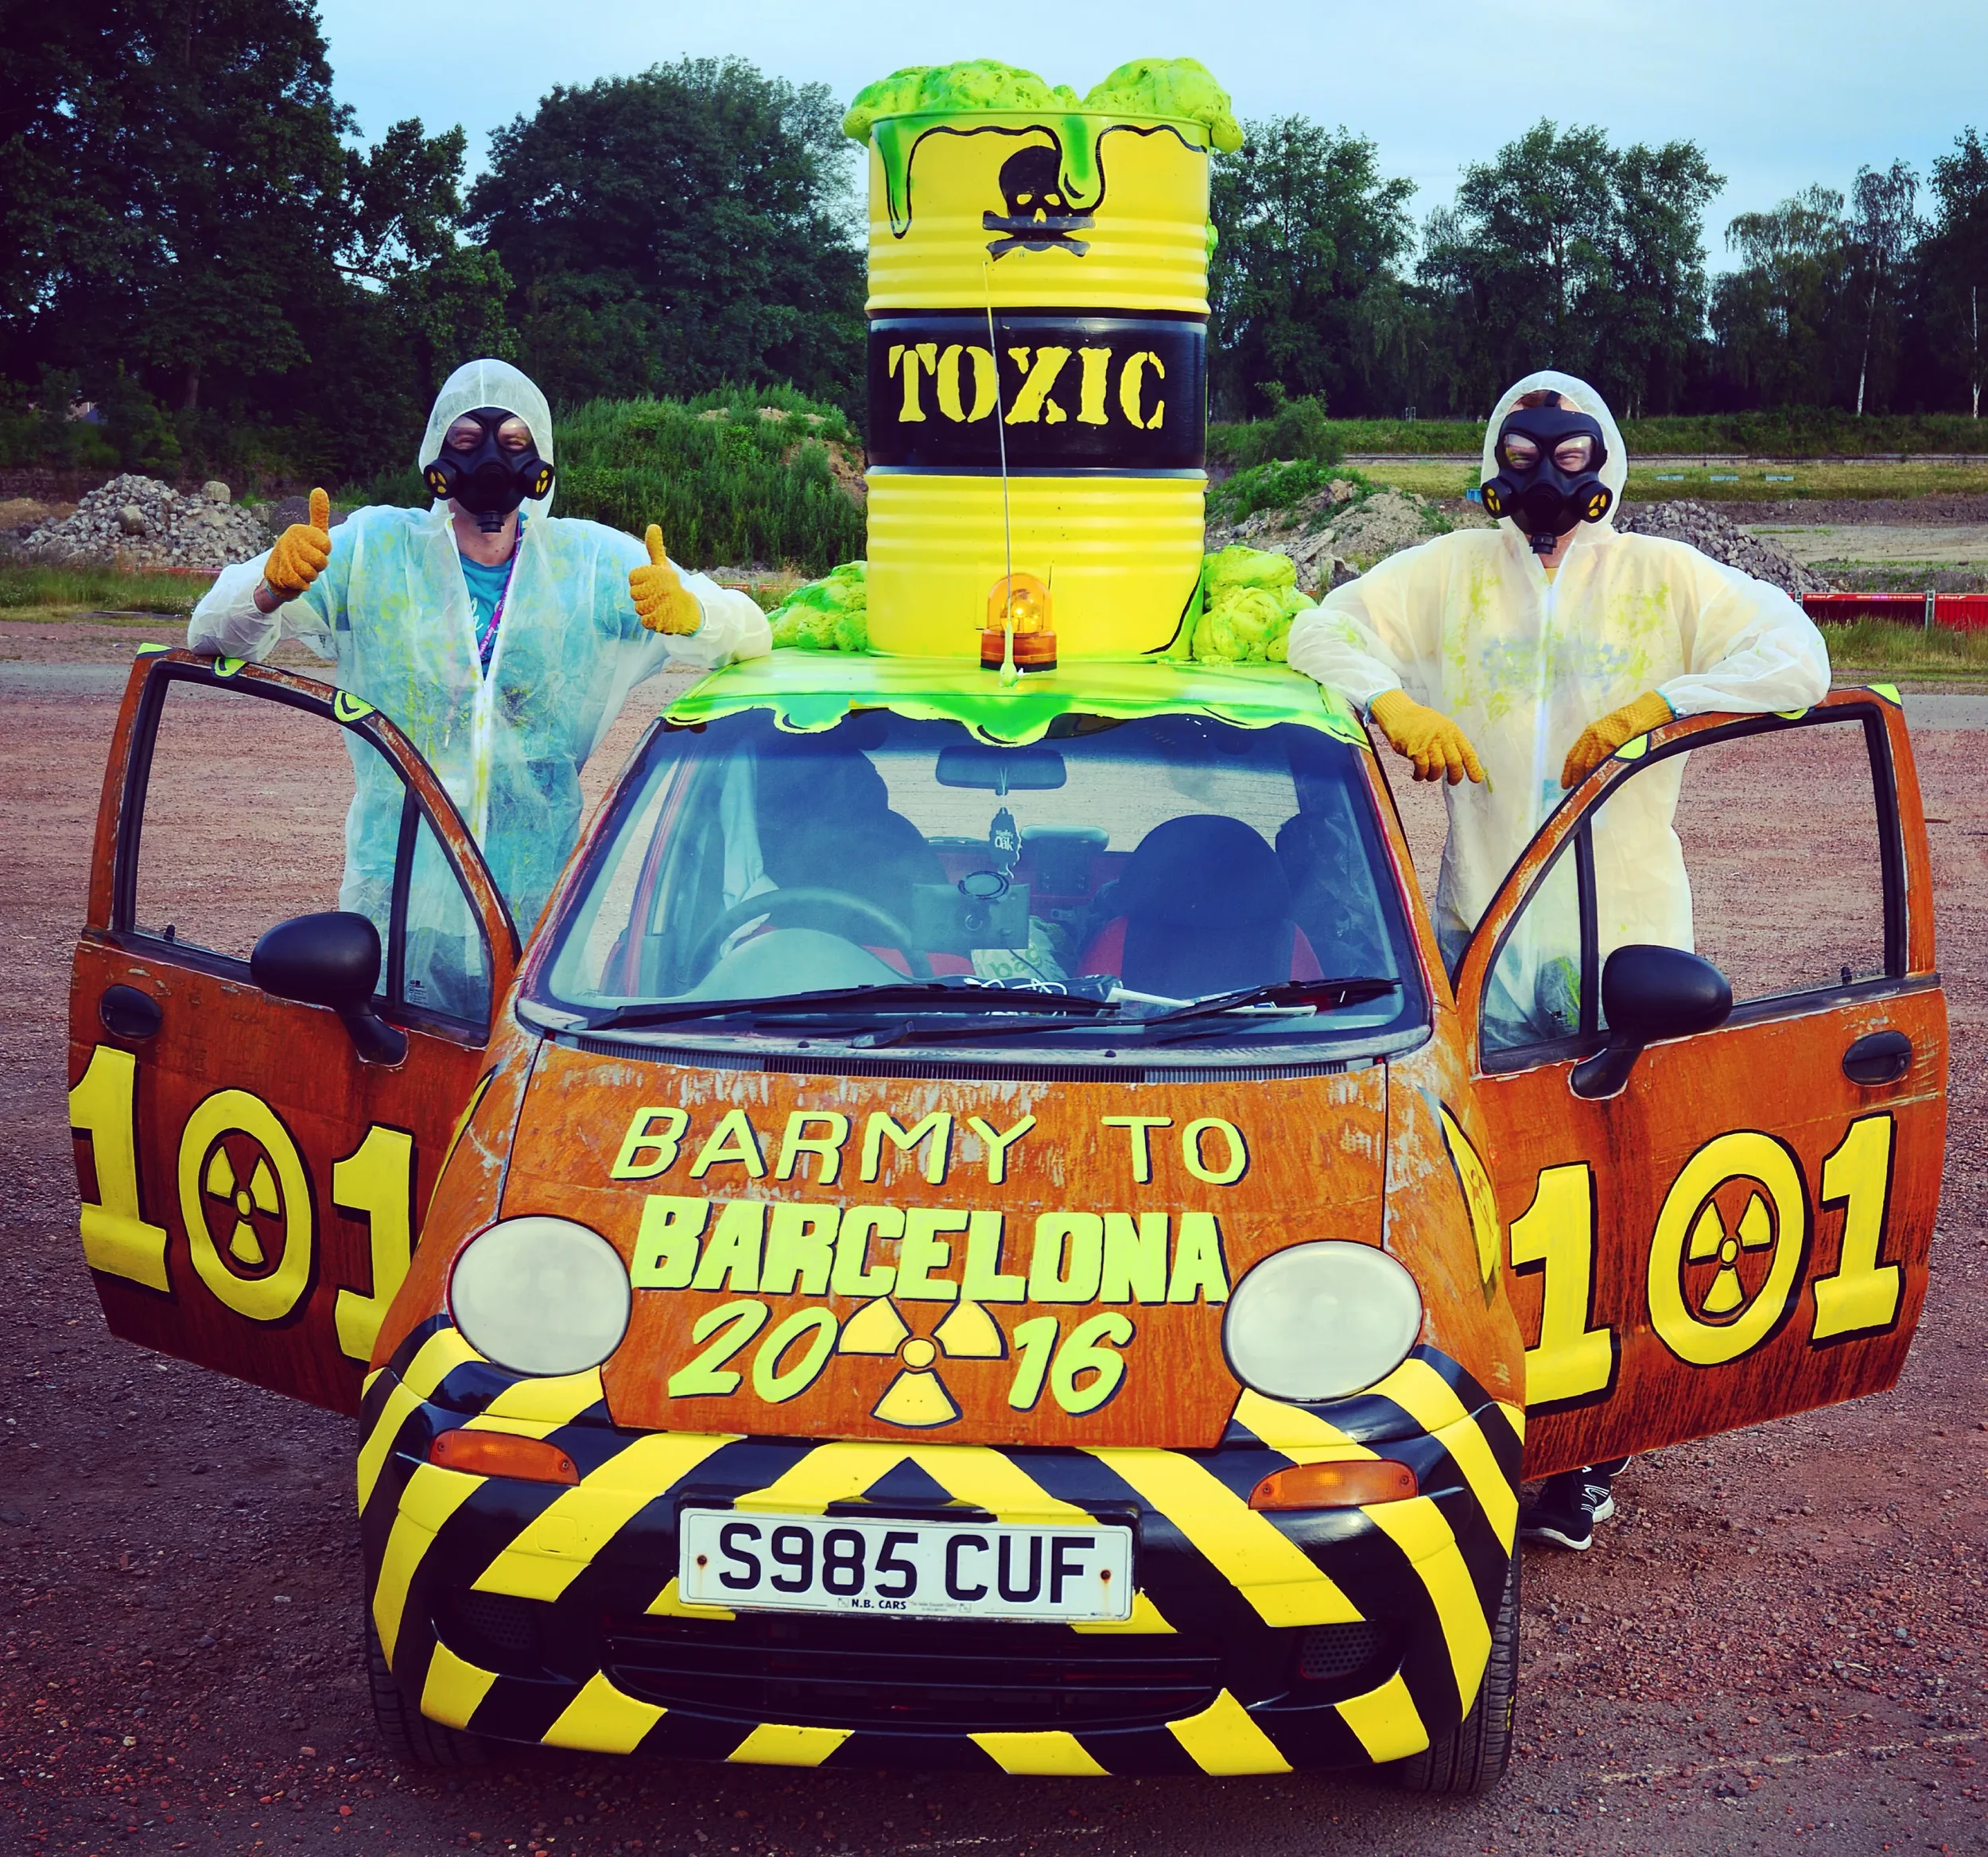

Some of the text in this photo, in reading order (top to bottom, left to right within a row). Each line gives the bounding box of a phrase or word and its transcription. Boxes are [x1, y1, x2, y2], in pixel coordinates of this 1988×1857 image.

[889, 343, 1166, 429] TOXIC
[994, 836, 1014, 851] Oak
[611, 1106, 1249, 1186] BARMY TO
[68, 1043, 414, 1362] 101
[631, 1194, 1230, 1304] BARCELONA
[1509, 1114, 1901, 1408] 101
[719, 1522, 1096, 1604] S985 CUF
[852, 1599, 875, 1609] N.B.
[878, 1599, 907, 1610] CARS
